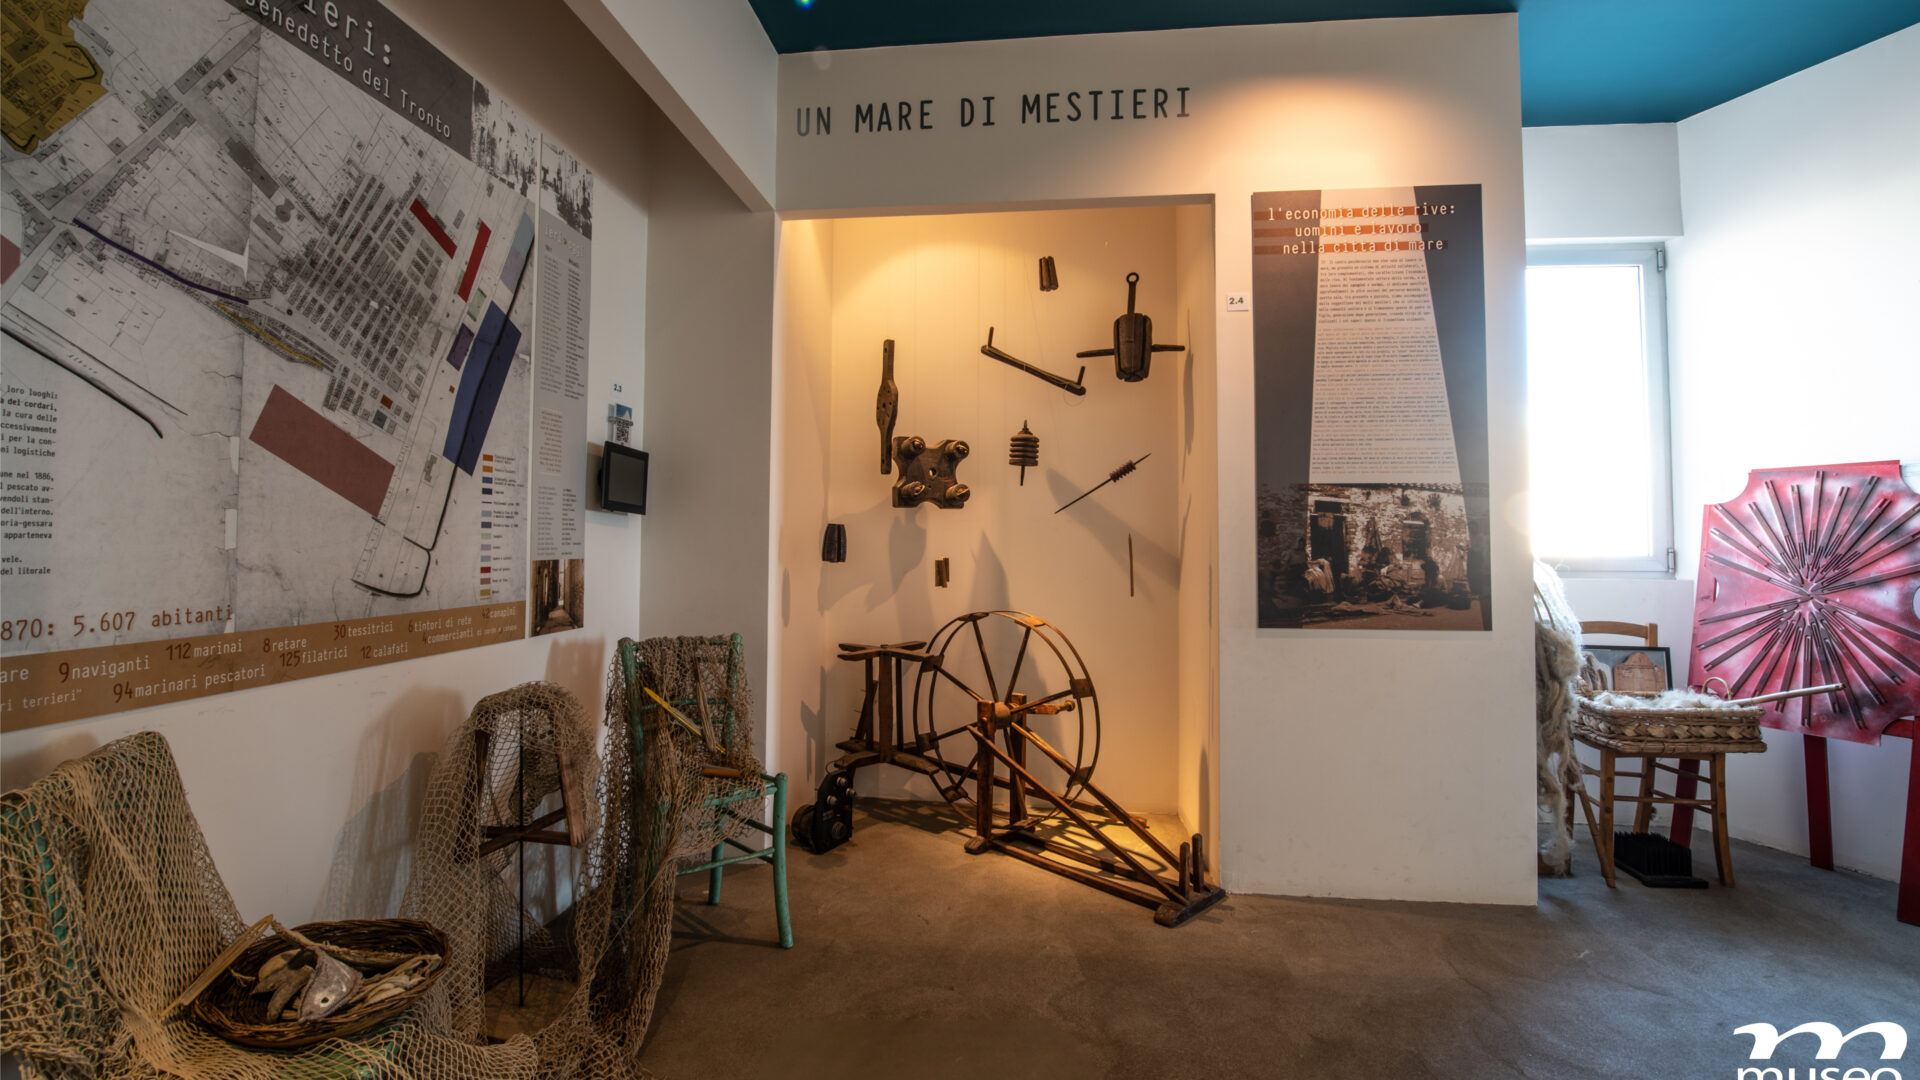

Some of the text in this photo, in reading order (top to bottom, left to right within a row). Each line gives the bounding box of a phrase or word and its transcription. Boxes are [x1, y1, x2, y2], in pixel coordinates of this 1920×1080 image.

[362, 67, 390, 99] del
[400, 88, 451, 138] Tronto
[796, 86, 1191, 137] UN MARE DI MESTIERI
[1268, 202, 1455, 221] l'economia delle rive:
[1295, 221, 1422, 237] uomini e lavoro
[1283, 240, 1325, 255] nella
[1384, 238, 1400, 252] di
[1408, 238, 1444, 251] mare
[1229, 297, 1244, 305] 2.4
[7, 385, 25, 395] loro
[24, 401, 57, 412] cordari,
[2, 409, 57, 423] la cura delle
[27, 435, 35, 444] la
[14, 446, 56, 457] logistiche
[7, 483, 39, 491] pescato
[4, 531, 53, 540] apparteneva
[0, 566, 51, 575] del litorale
[73, 611, 136, 637] 5.607
[151, 604, 233, 628] abitanti
[0, 668, 29, 683] are
[72, 655, 151, 679] naviganti
[165, 642, 192, 661] 112
[193, 638, 243, 658] marinai
[272, 637, 307, 652] retare
[347, 620, 394, 637] tessitrici
[113, 681, 133, 704] 94
[135, 674, 198, 698] marinari
[205, 664, 265, 689] pescatori
[302, 645, 348, 664] filatrici
